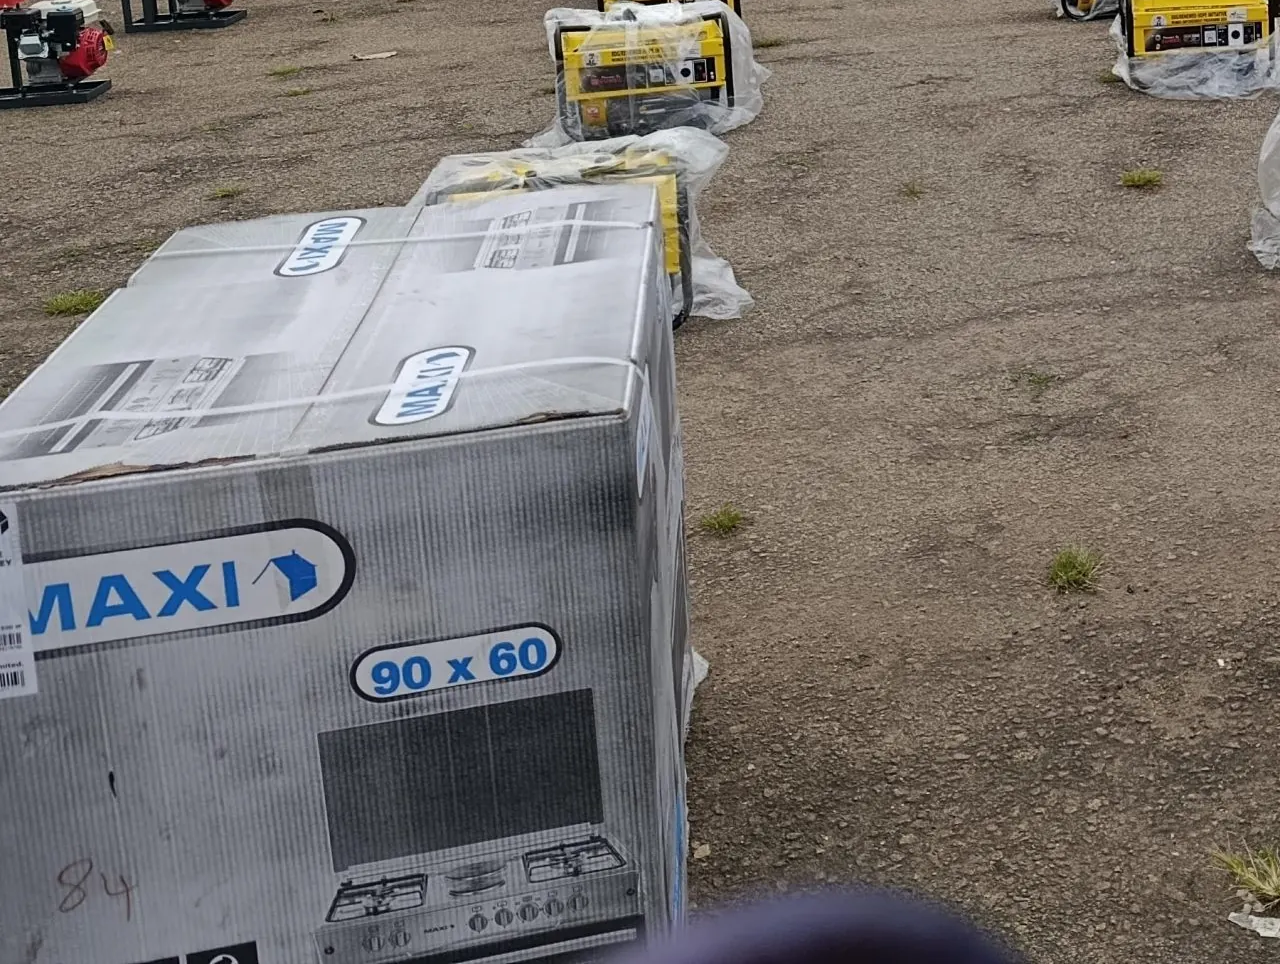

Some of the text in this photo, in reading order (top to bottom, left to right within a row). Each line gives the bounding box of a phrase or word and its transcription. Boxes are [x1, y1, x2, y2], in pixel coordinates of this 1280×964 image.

[297, 222, 348, 260] MAXI
[396, 365, 455, 418] MAXI
[370, 636, 548, 695] 90 x 60
[57, 858, 139, 922] 84
